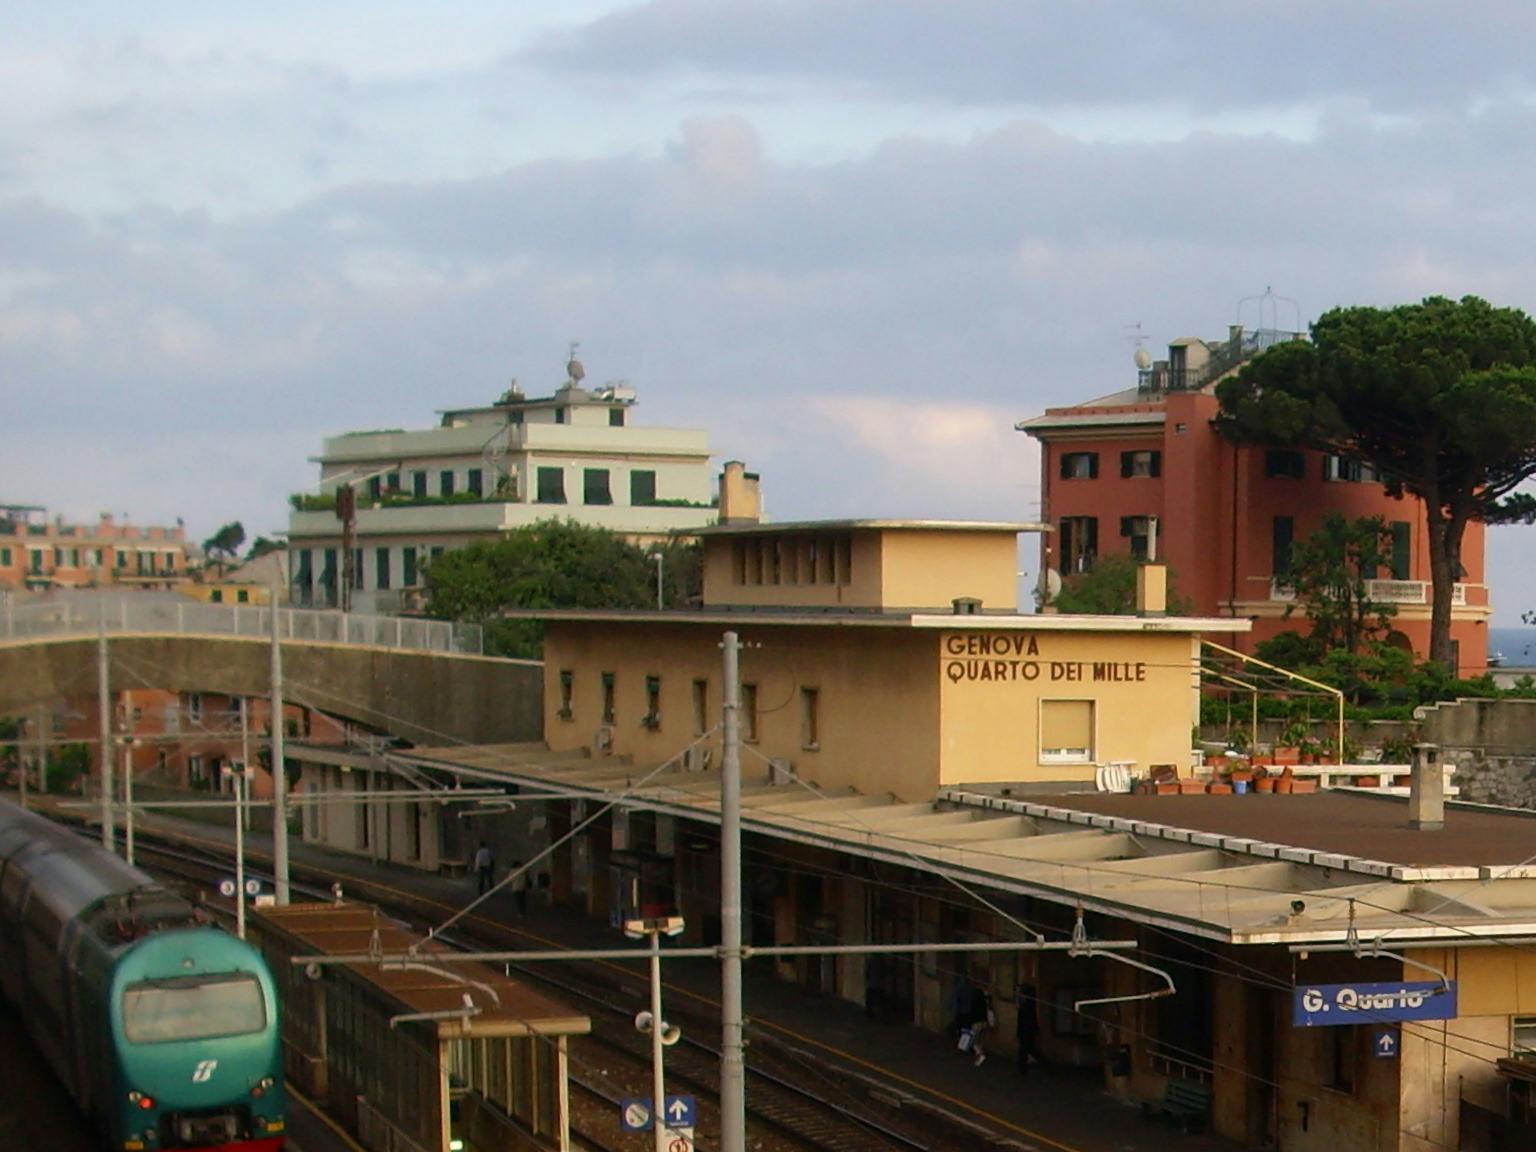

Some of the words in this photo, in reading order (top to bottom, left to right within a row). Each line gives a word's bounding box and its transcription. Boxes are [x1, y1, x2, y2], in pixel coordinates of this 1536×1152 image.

[947, 635, 1040, 656] GENOVA
[947, 660, 1040, 684] QUARTO
[1051, 662, 1082, 681] DEI
[1093, 663, 1146, 682] MILLE
[1302, 988, 1330, 1012] G.
